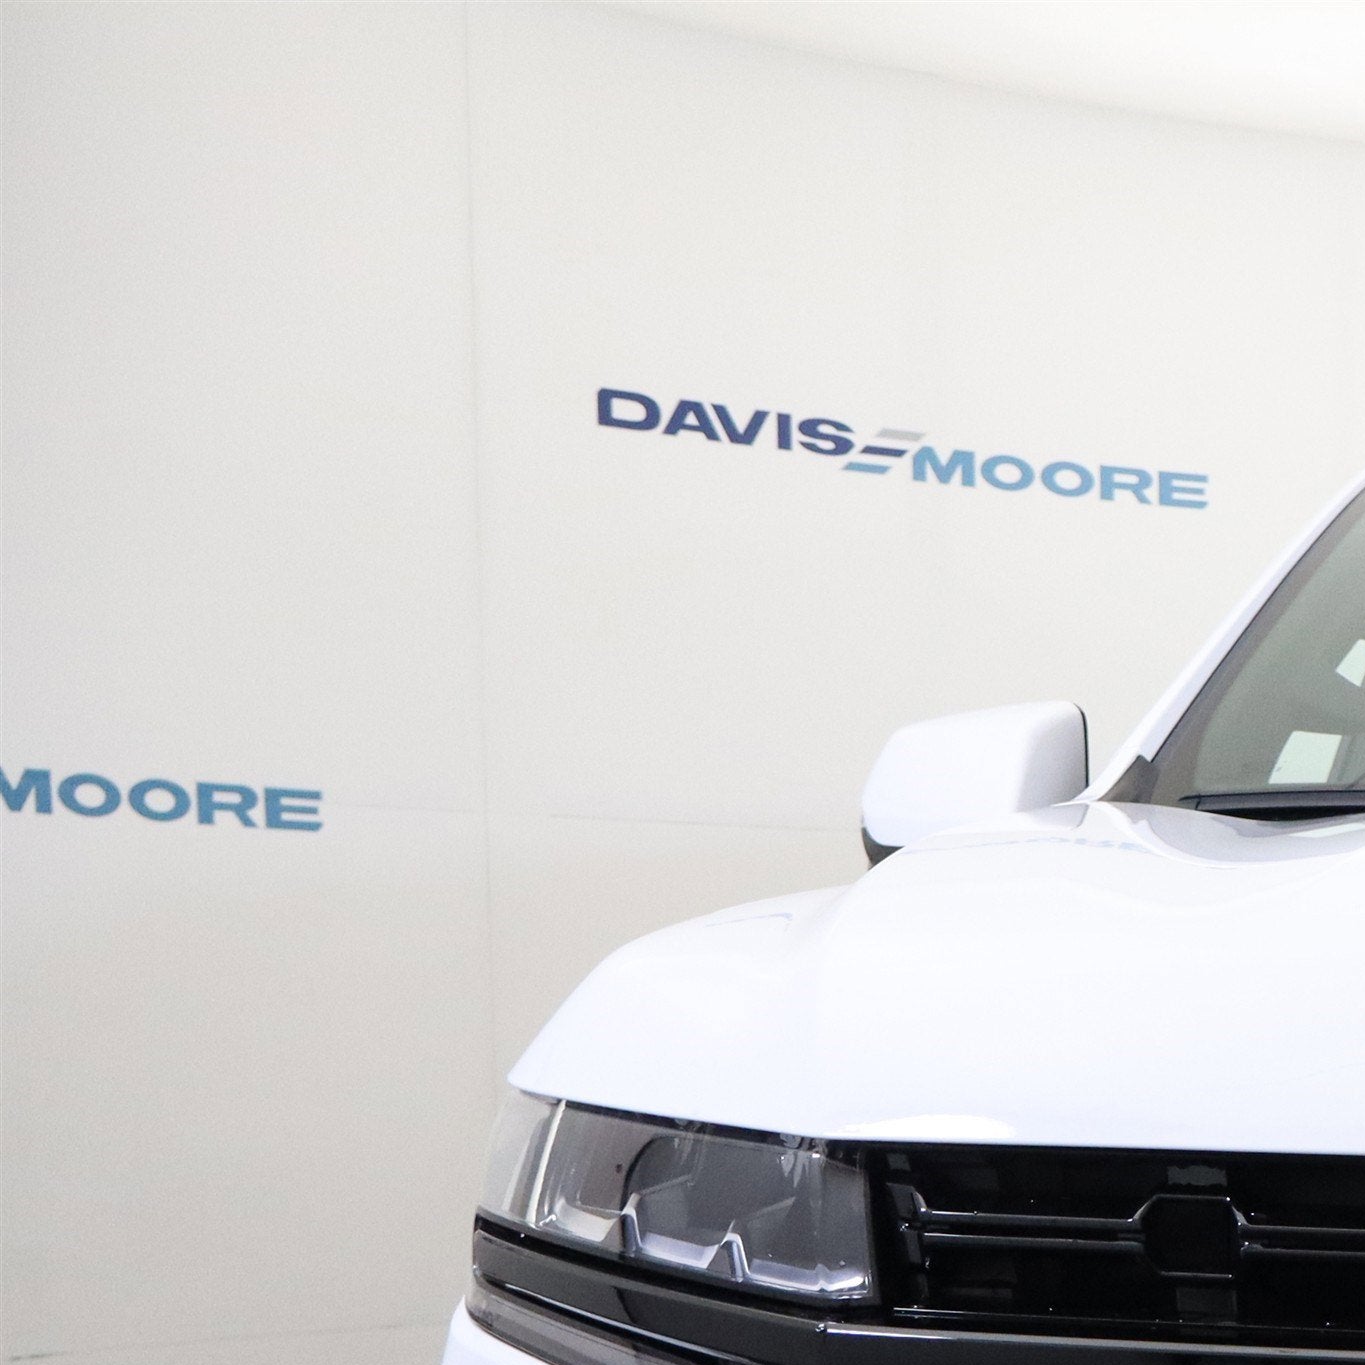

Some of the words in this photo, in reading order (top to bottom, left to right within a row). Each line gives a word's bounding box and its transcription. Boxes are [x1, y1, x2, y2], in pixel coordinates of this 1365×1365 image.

[596, 387, 855, 457] DAVIS
[911, 446, 1210, 510] MOORE
[0, 766, 323, 832] MOORE
